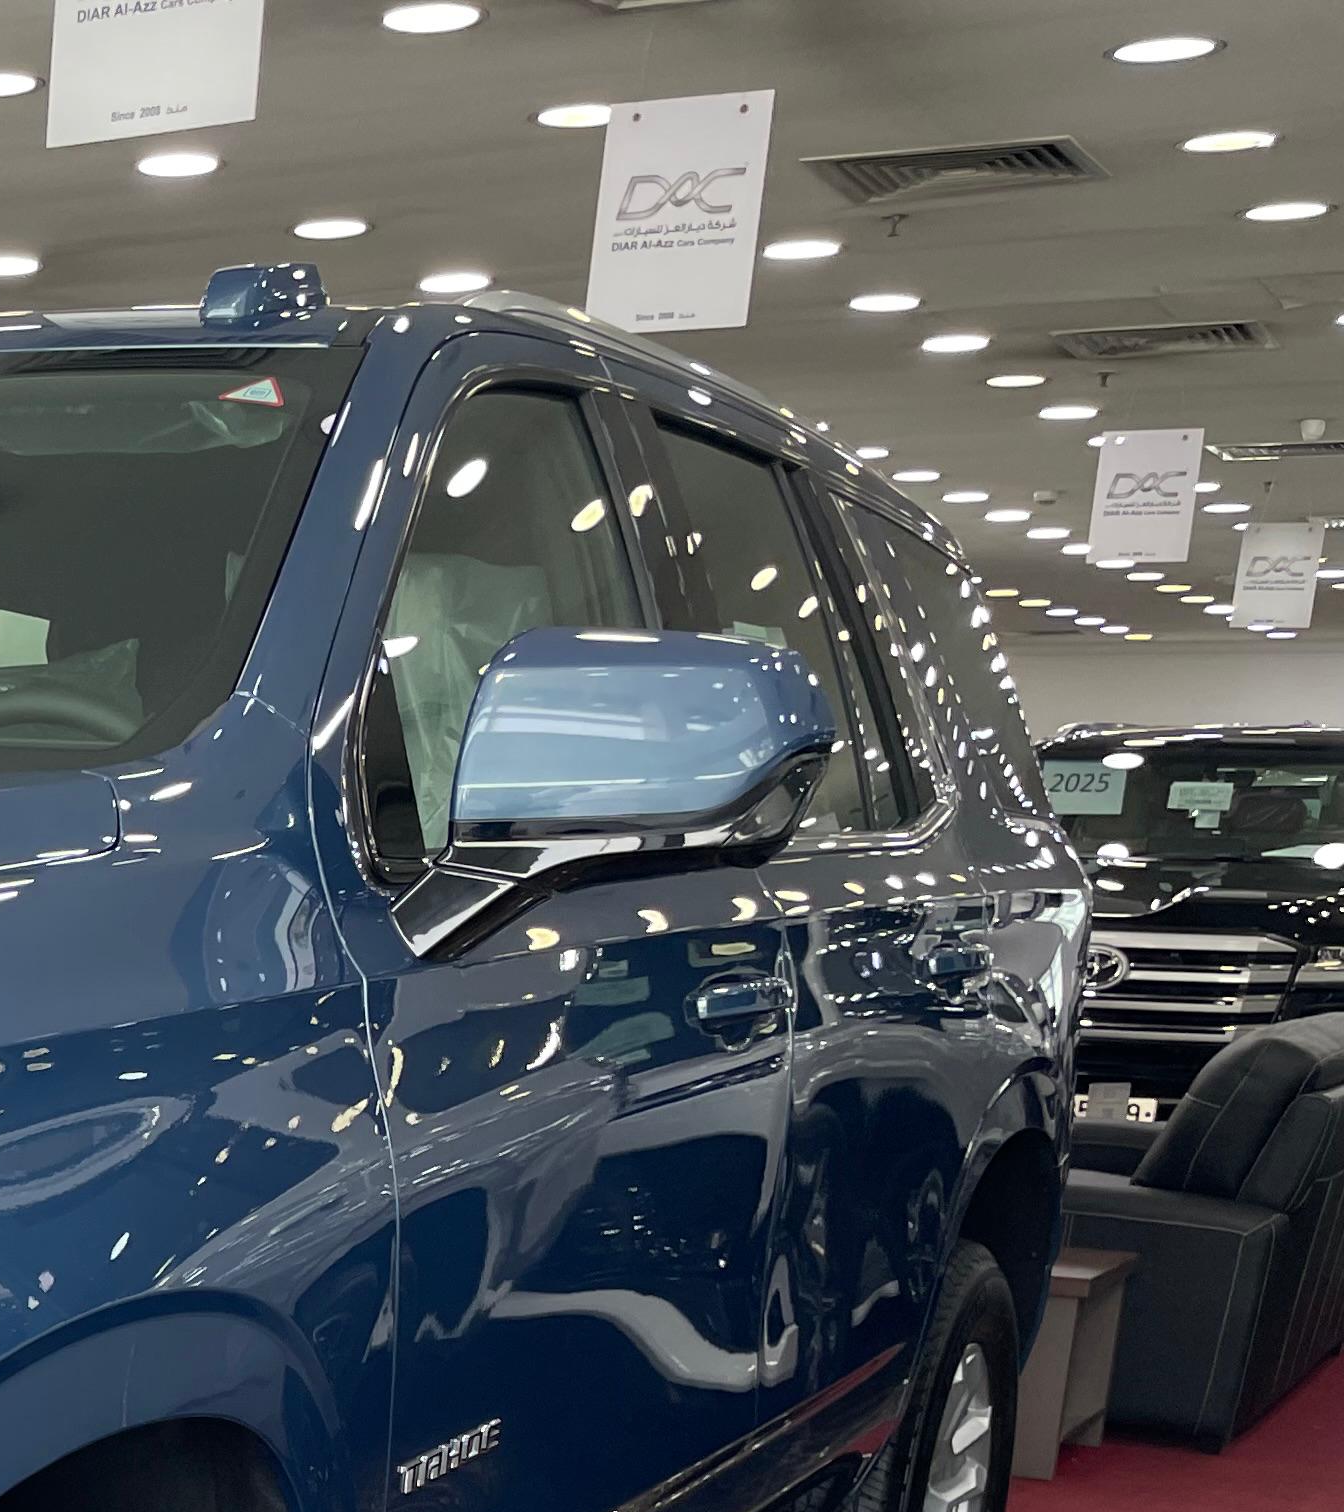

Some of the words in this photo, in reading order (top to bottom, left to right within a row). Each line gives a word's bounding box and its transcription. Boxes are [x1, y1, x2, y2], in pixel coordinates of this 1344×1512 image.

[77, 6, 110, 23] DIAR
[114, 0, 157, 17] Al-Azz
[611, 240, 638, 252] DIAR
[1049, 772, 1112, 793] 2025
[396, 1417, 503, 1494] TAHOE
